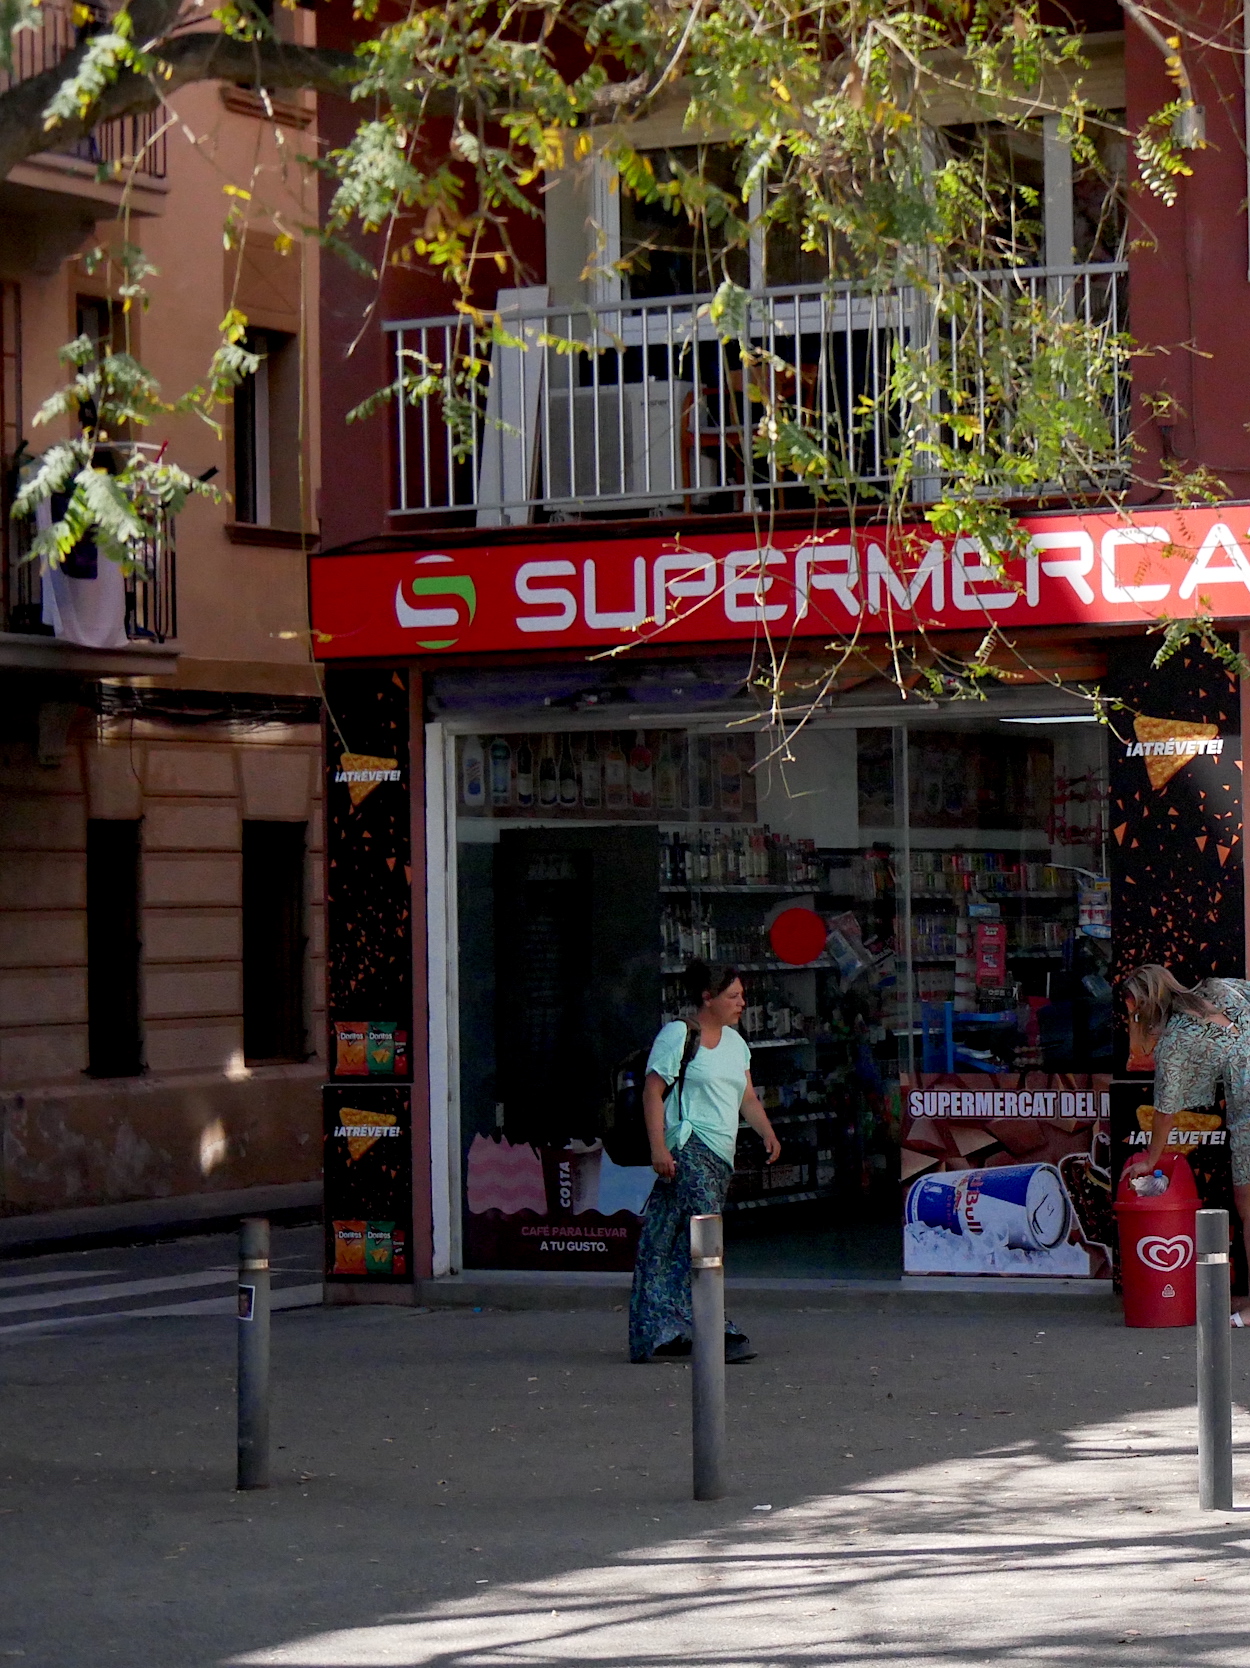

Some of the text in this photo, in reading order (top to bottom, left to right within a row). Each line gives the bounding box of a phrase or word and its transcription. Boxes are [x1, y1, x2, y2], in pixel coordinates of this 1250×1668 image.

[909, 1091, 1056, 1118] SUPERMERCAT
[1060, 1091, 1097, 1118] DEL
[334, 1124, 400, 1138] ¡ATRÉVETE!
[1128, 1127, 1227, 1146] ¡ATÉVETE!
[558, 1161, 572, 1208] COSTA
[521, 1224, 627, 1238] CAFÉ PARA LLEVAR
[540, 1241, 609, 1252] A TU GUSTO.
